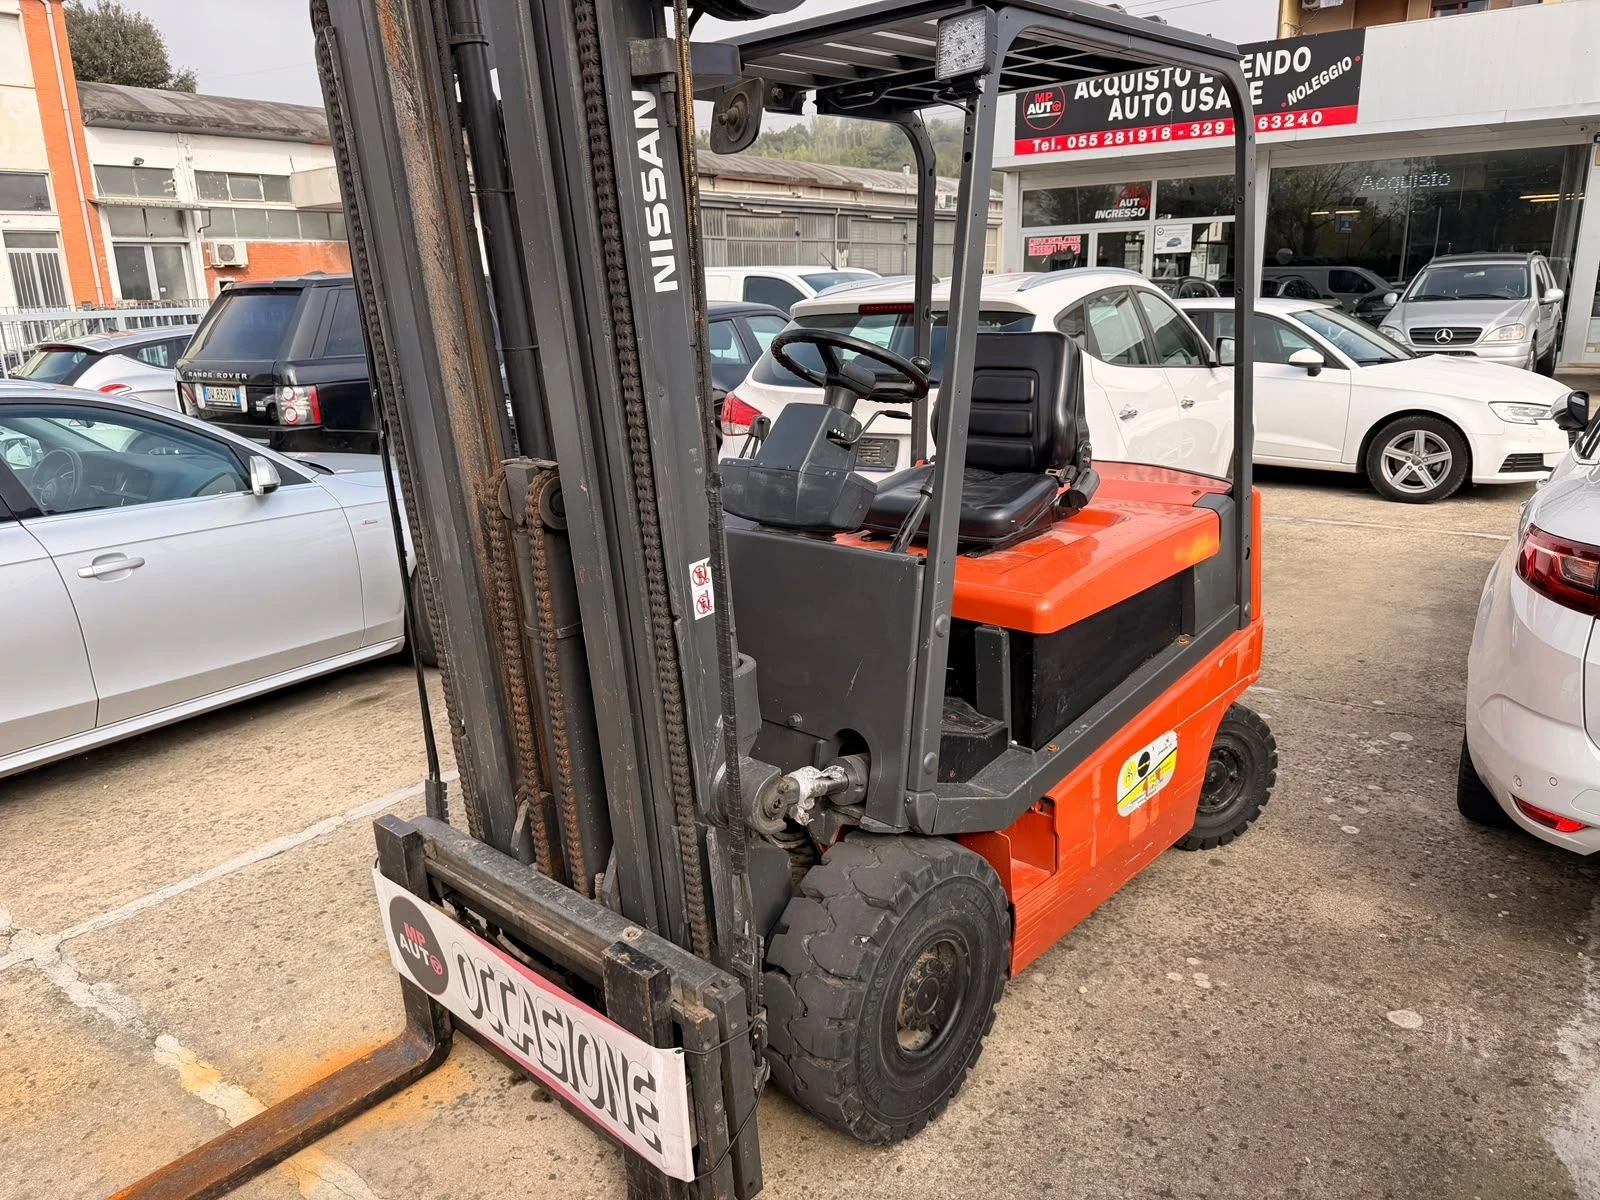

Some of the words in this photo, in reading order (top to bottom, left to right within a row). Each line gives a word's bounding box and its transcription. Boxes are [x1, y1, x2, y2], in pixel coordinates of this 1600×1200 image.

[1074, 67, 1192, 100] ACQUISTO
[1240, 46, 1312, 79] ENDO
[1287, 56, 1352, 106] NOLEGGIO
[1034, 92, 1053, 103] MP
[1108, 91, 1173, 121] AUTO
[1181, 81, 1263, 113] USAE
[1033, 138, 1061, 151] Tel.
[1067, 133, 1098, 149] 055
[1103, 127, 1170, 146] 281918
[1190, 121, 1225, 137] 329
[631, 90, 679, 293] NISSAN
[1360, 171, 1451, 194] Acquisto
[1094, 207, 1146, 220] INGRESSO
[217, 372, 248, 380] ROVER
[403, 922, 426, 946] MP
[452, 942, 663, 1155] OCCASIONE
